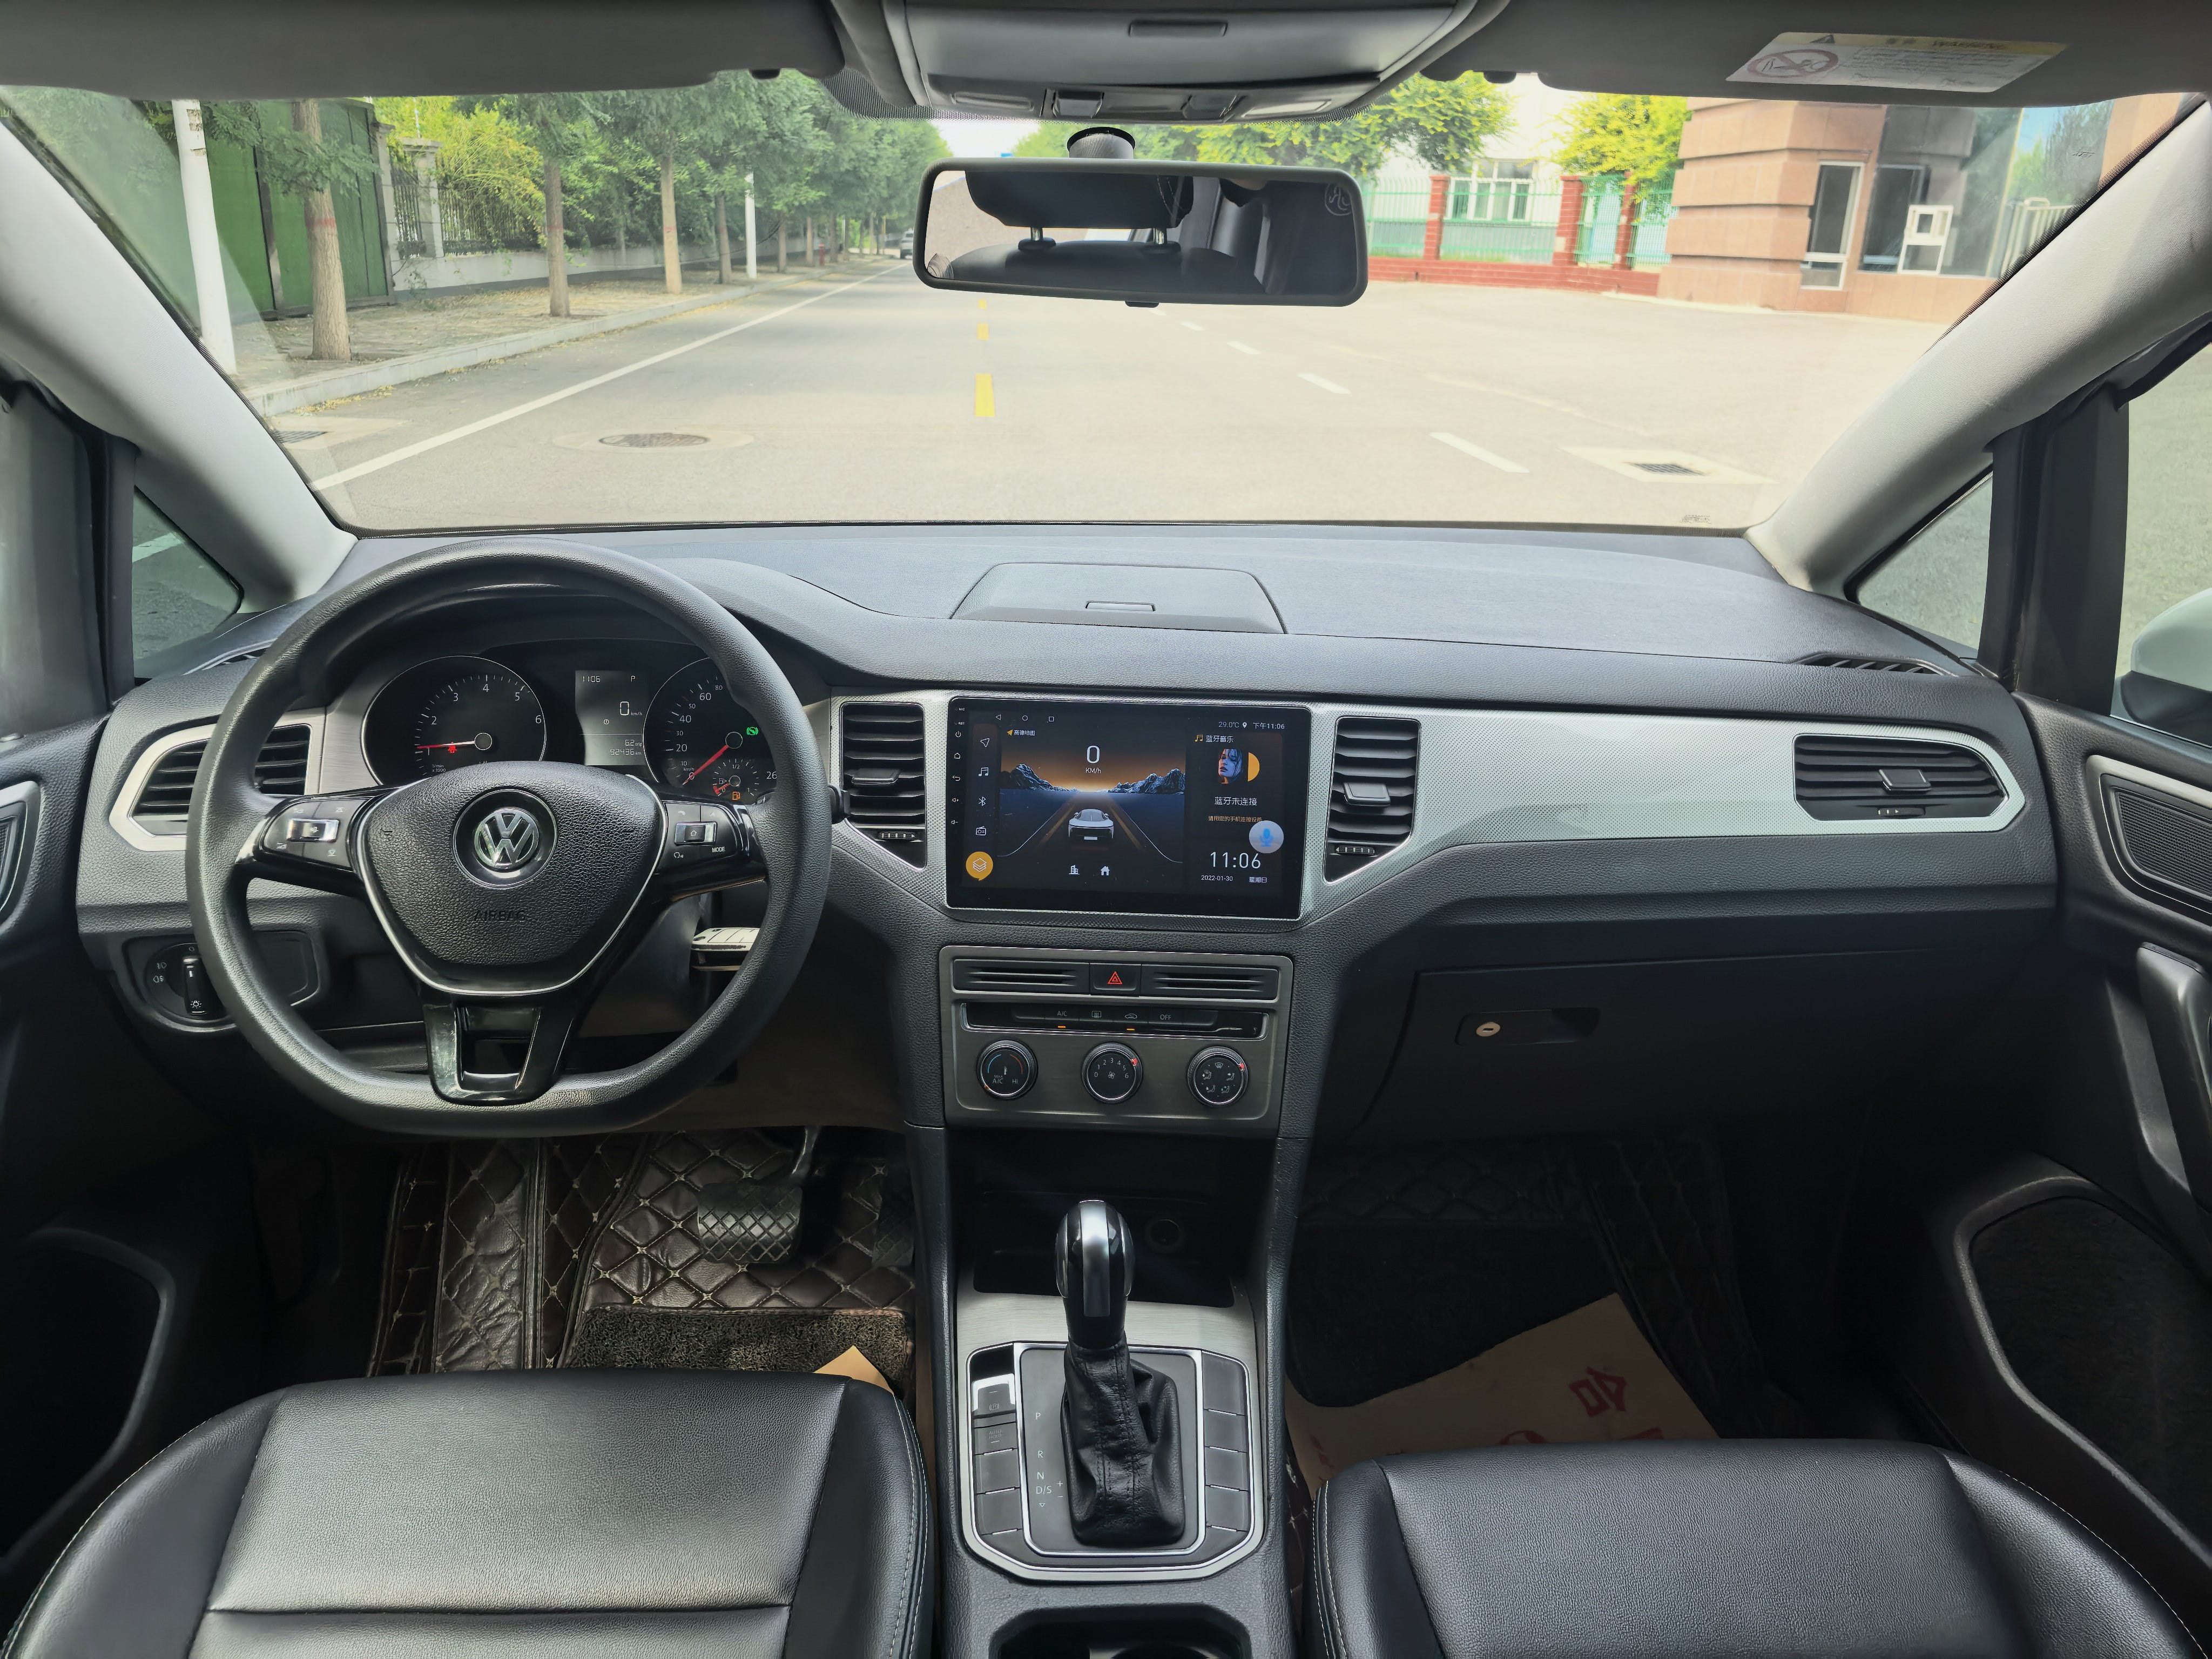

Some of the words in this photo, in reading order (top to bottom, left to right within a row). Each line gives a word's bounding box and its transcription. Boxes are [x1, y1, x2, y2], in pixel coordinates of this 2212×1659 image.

[482, 684, 490, 692] 4
[453, 692, 458, 702] 3
[515, 692, 521, 701] 5
[699, 692, 711, 700] 60
[620, 701, 630, 716] 0
[431, 716, 437, 725] 2
[535, 714, 542, 724] 6
[1205, 734, 1234, 743] 蓝牙音乐
[676, 744, 687, 752] 20
[1086, 745, 1101, 764] 0
[766, 771, 778, 779] 26
[1214, 797, 1257, 806] 蓝牙未连接
[1210, 851, 1261, 869] 11:06
[1037, 1450, 1043, 1458] R
[1037, 1472, 1044, 1480] N
[1036, 1485, 1052, 1494] D/S
